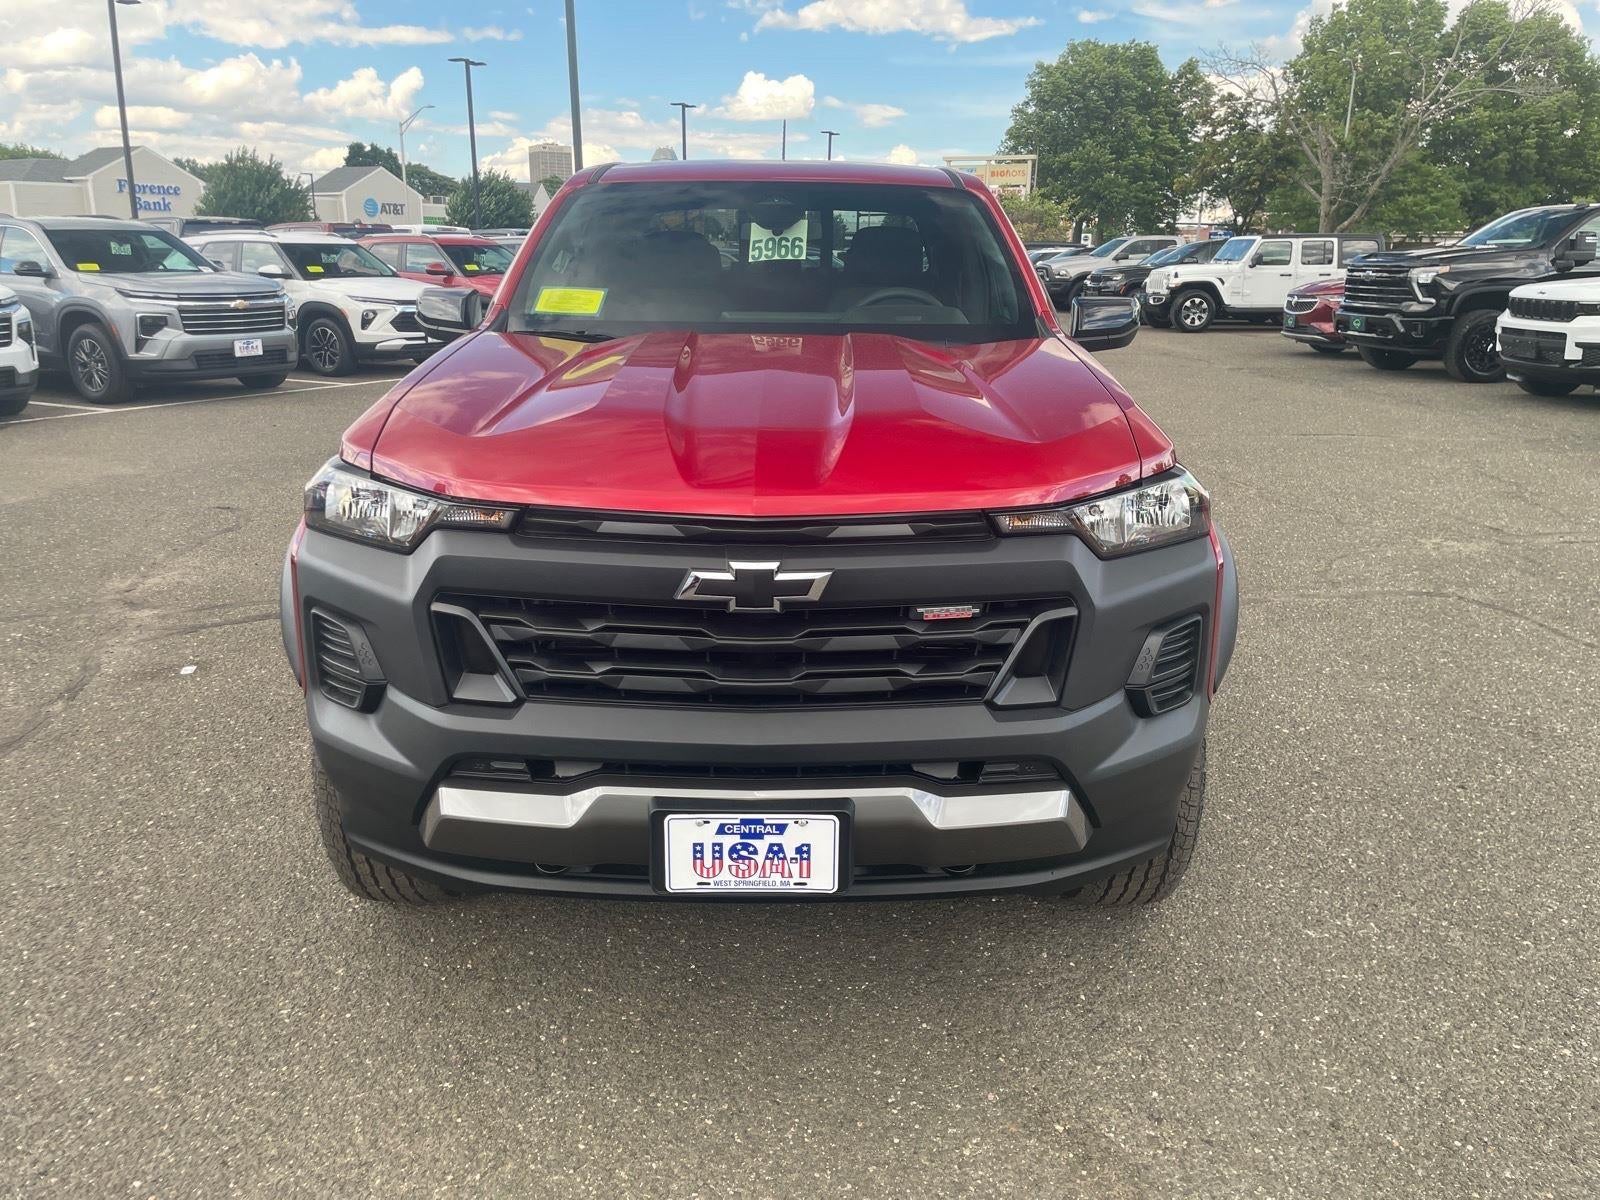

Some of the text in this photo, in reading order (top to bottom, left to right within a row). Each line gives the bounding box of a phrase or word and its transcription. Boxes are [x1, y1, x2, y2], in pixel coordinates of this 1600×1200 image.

[117, 179, 180, 195] Forence
[381, 203, 405, 215] AT&T
[751, 237, 804, 260] 5966
[724, 826, 780, 834] CENTRAL
[692, 842, 811, 878] USA-1
[733, 880, 779, 888] SPRINGFIELD,
